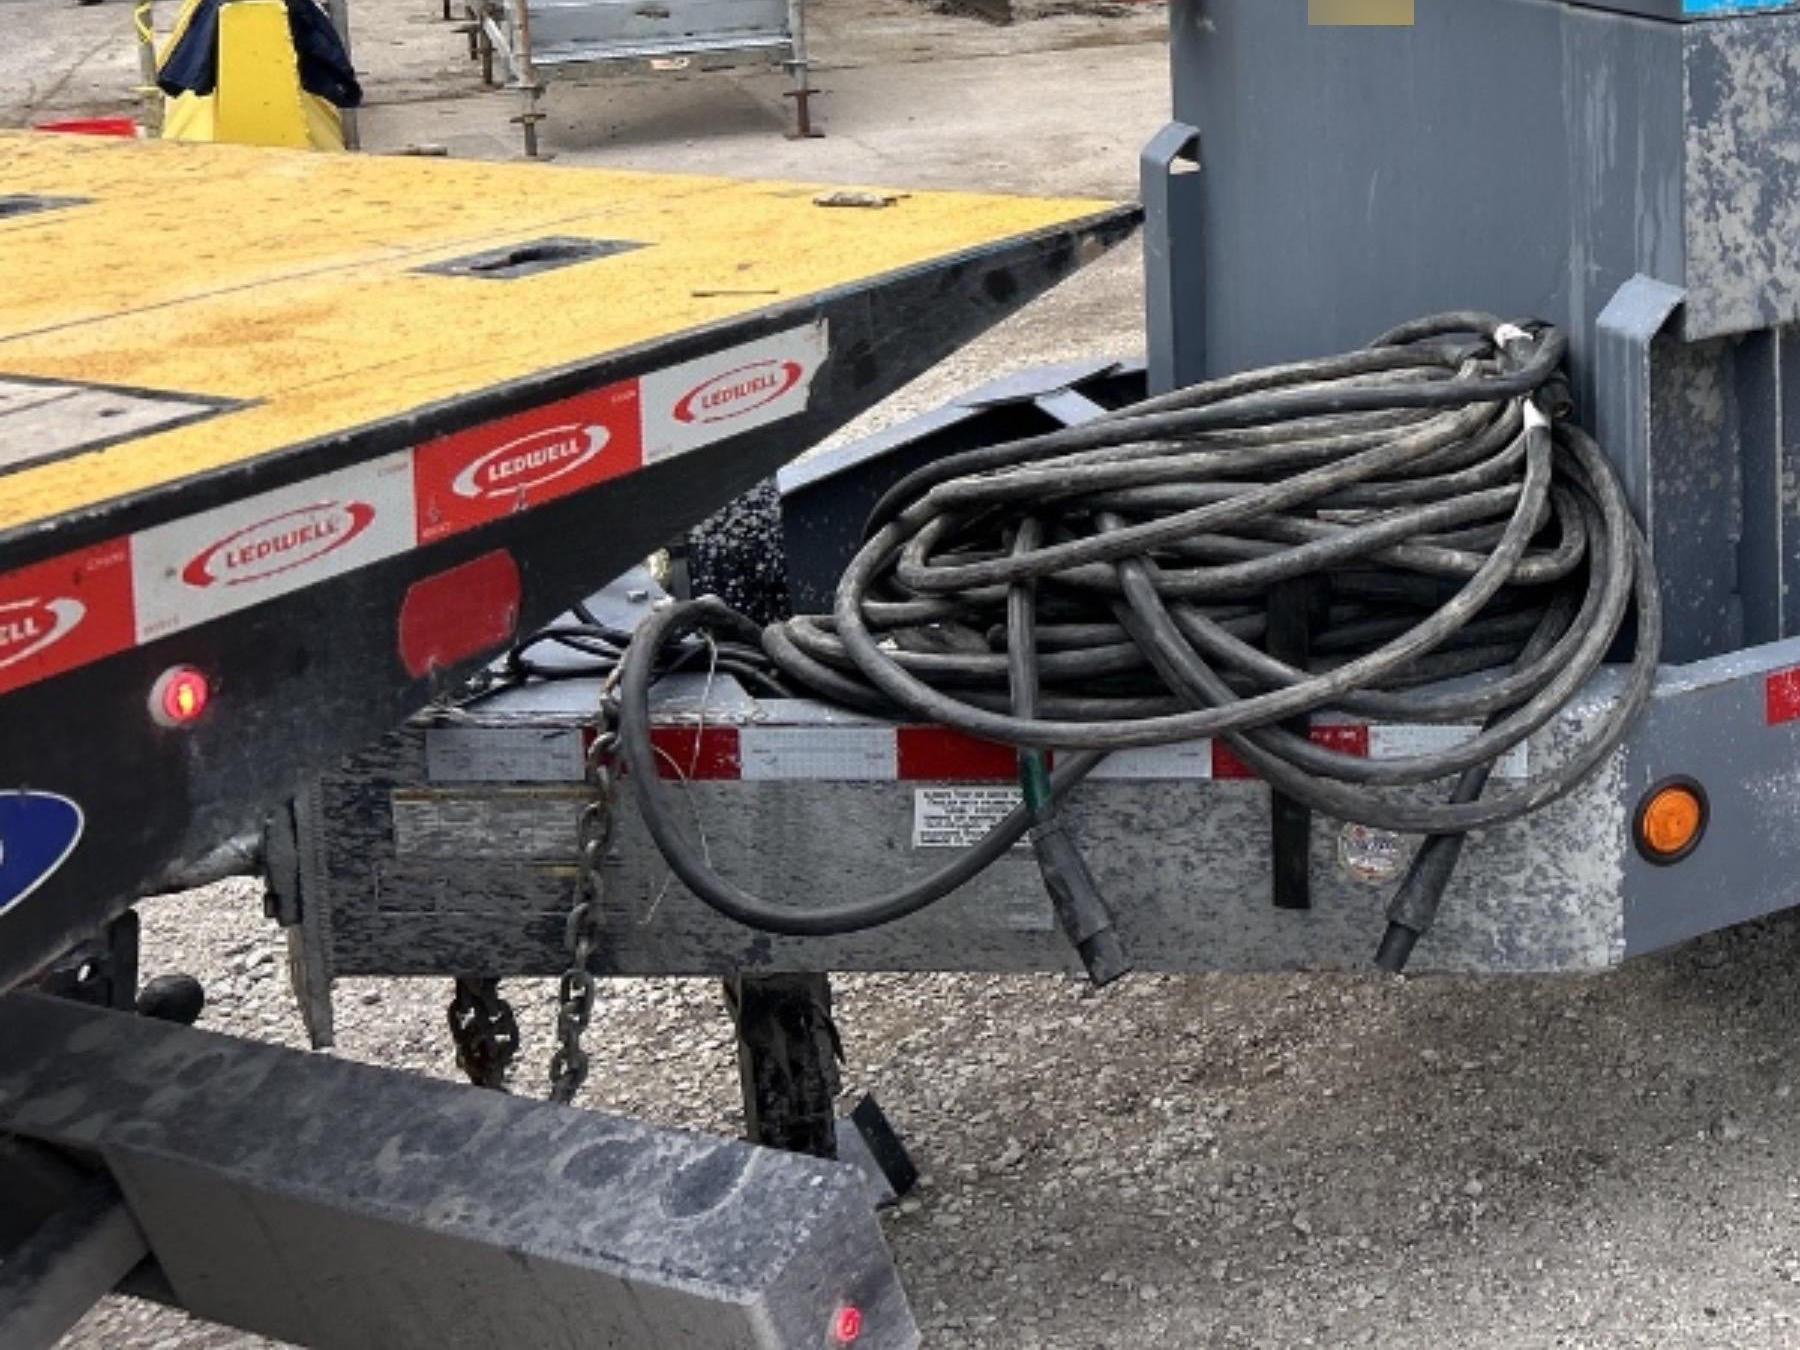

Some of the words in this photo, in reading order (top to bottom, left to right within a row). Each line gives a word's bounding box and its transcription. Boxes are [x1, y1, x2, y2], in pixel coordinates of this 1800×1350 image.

[701, 372, 777, 410] LEDWELL
[487, 437, 581, 482] LEDWELL
[226, 517, 341, 569] LEDWELL
